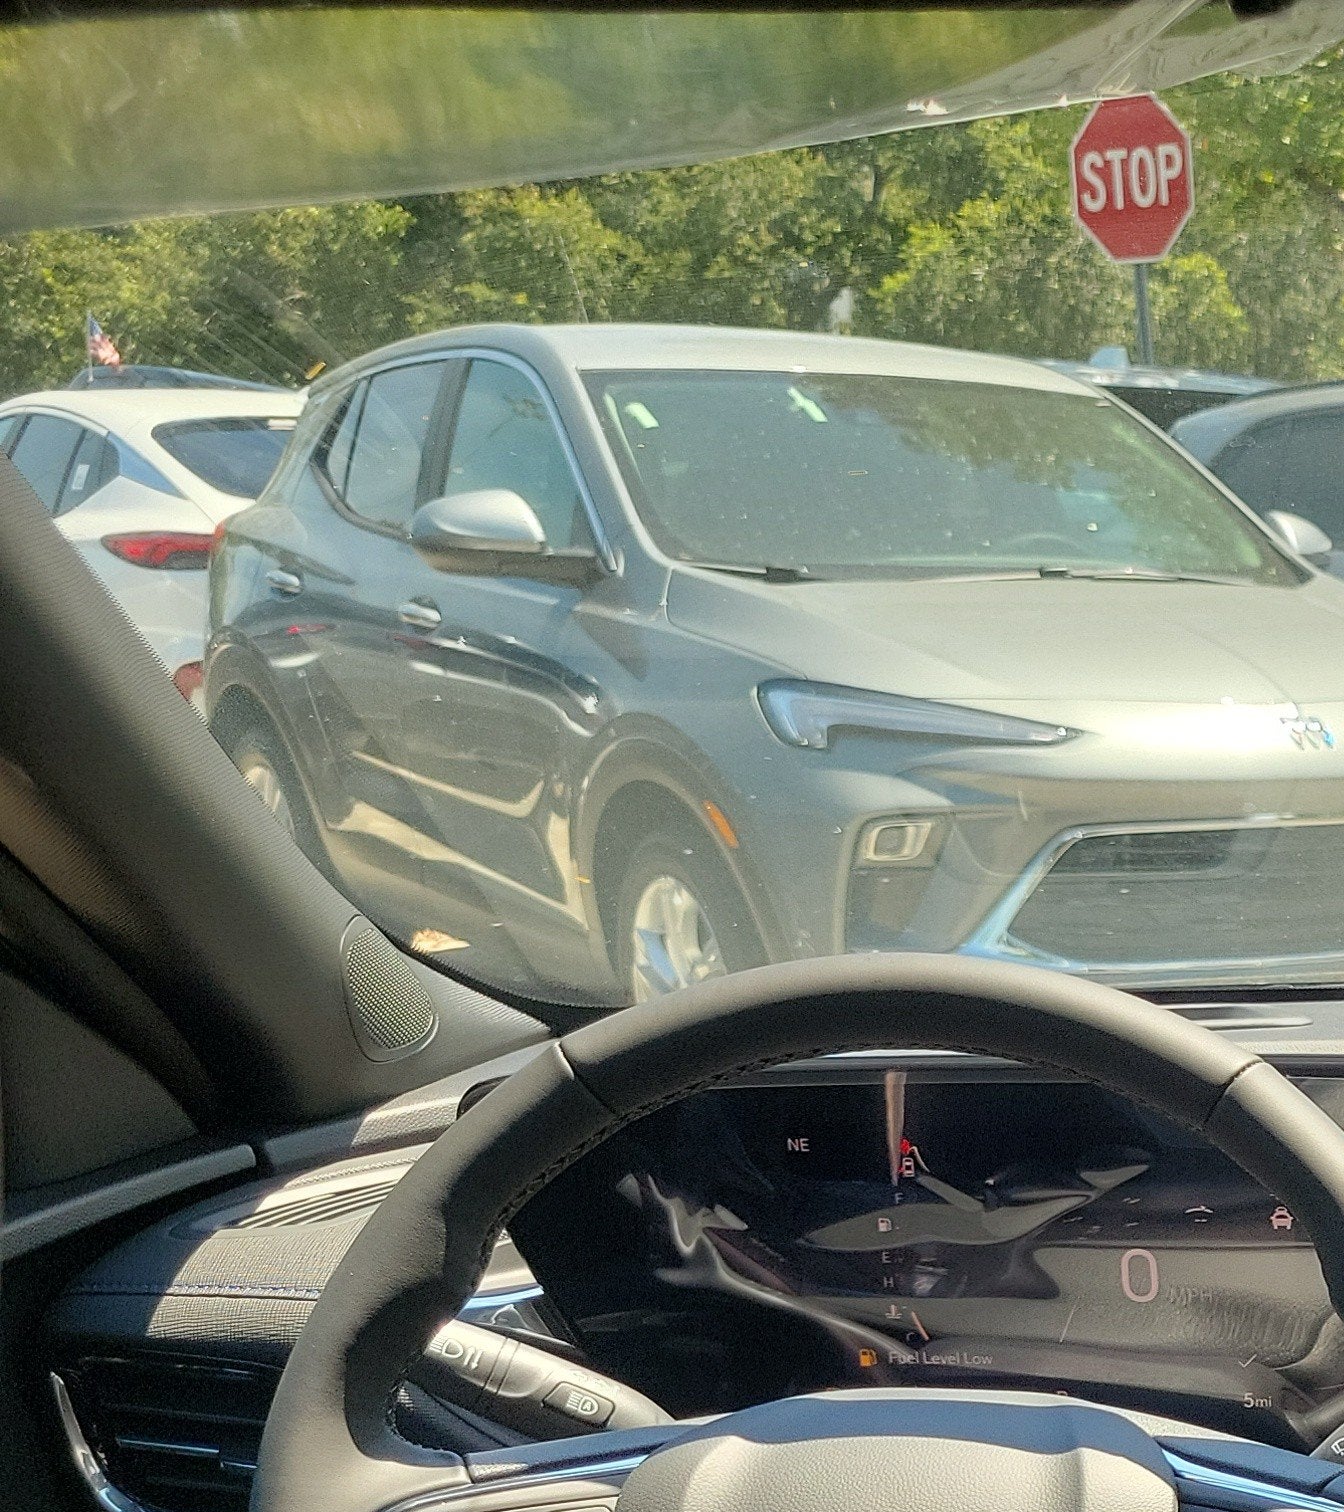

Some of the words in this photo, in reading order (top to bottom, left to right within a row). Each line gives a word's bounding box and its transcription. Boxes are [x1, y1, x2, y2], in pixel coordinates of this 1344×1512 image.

[1080, 142, 1183, 212] STOP
[786, 1138, 810, 1152] NE
[882, 1252, 892, 1264] E
[1120, 1248, 1159, 1303] 0
[923, 1351, 960, 1365] Level
[964, 1352, 993, 1365] Low
